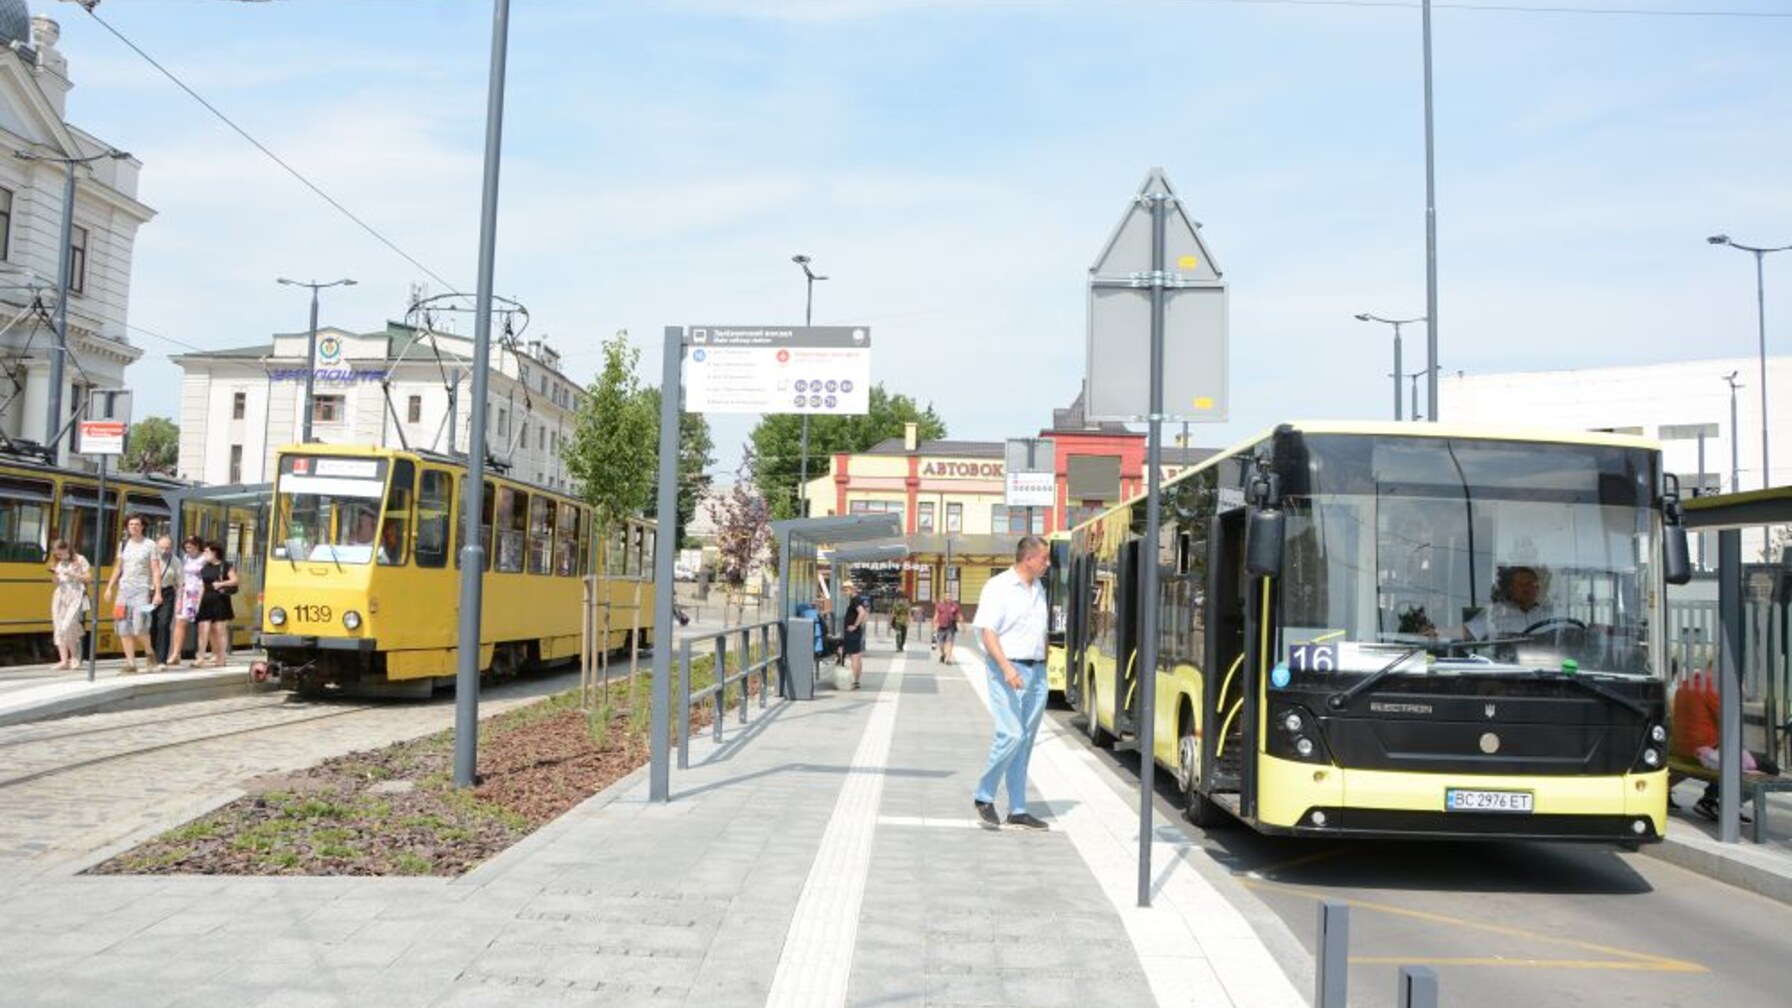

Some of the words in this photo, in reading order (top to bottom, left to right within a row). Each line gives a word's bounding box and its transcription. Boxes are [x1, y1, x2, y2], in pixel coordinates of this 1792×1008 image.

[922, 462, 1004, 477] АВТОВОК
[293, 604, 332, 622] 1139
[1293, 646, 1334, 672] 16
[1370, 702, 1433, 714] ELECTRON
[1478, 793, 1507, 807] 2976
[1510, 795, 1529, 808] ET
